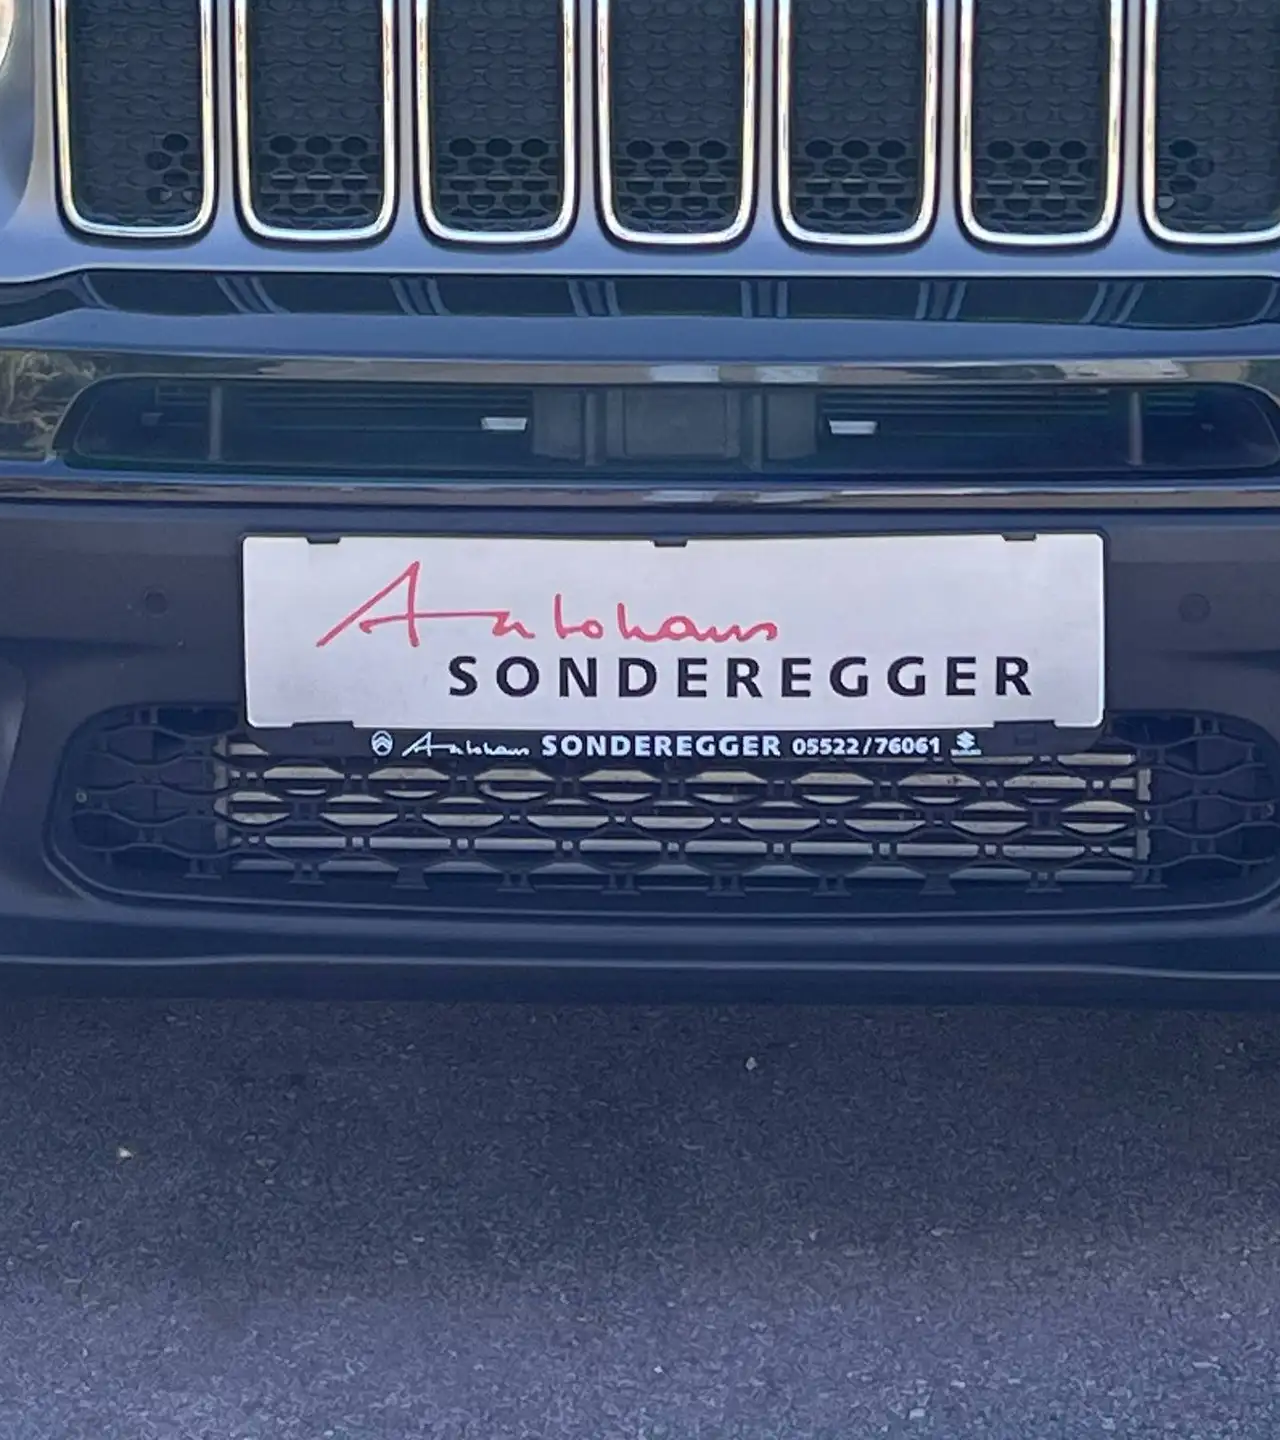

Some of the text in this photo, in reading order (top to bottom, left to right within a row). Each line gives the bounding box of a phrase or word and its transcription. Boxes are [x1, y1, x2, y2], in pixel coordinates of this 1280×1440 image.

[449, 655, 1032, 698] SONDEREGGER
[541, 734, 781, 757] SONDEREGGER
[791, 736, 941, 756] 05522/76061
